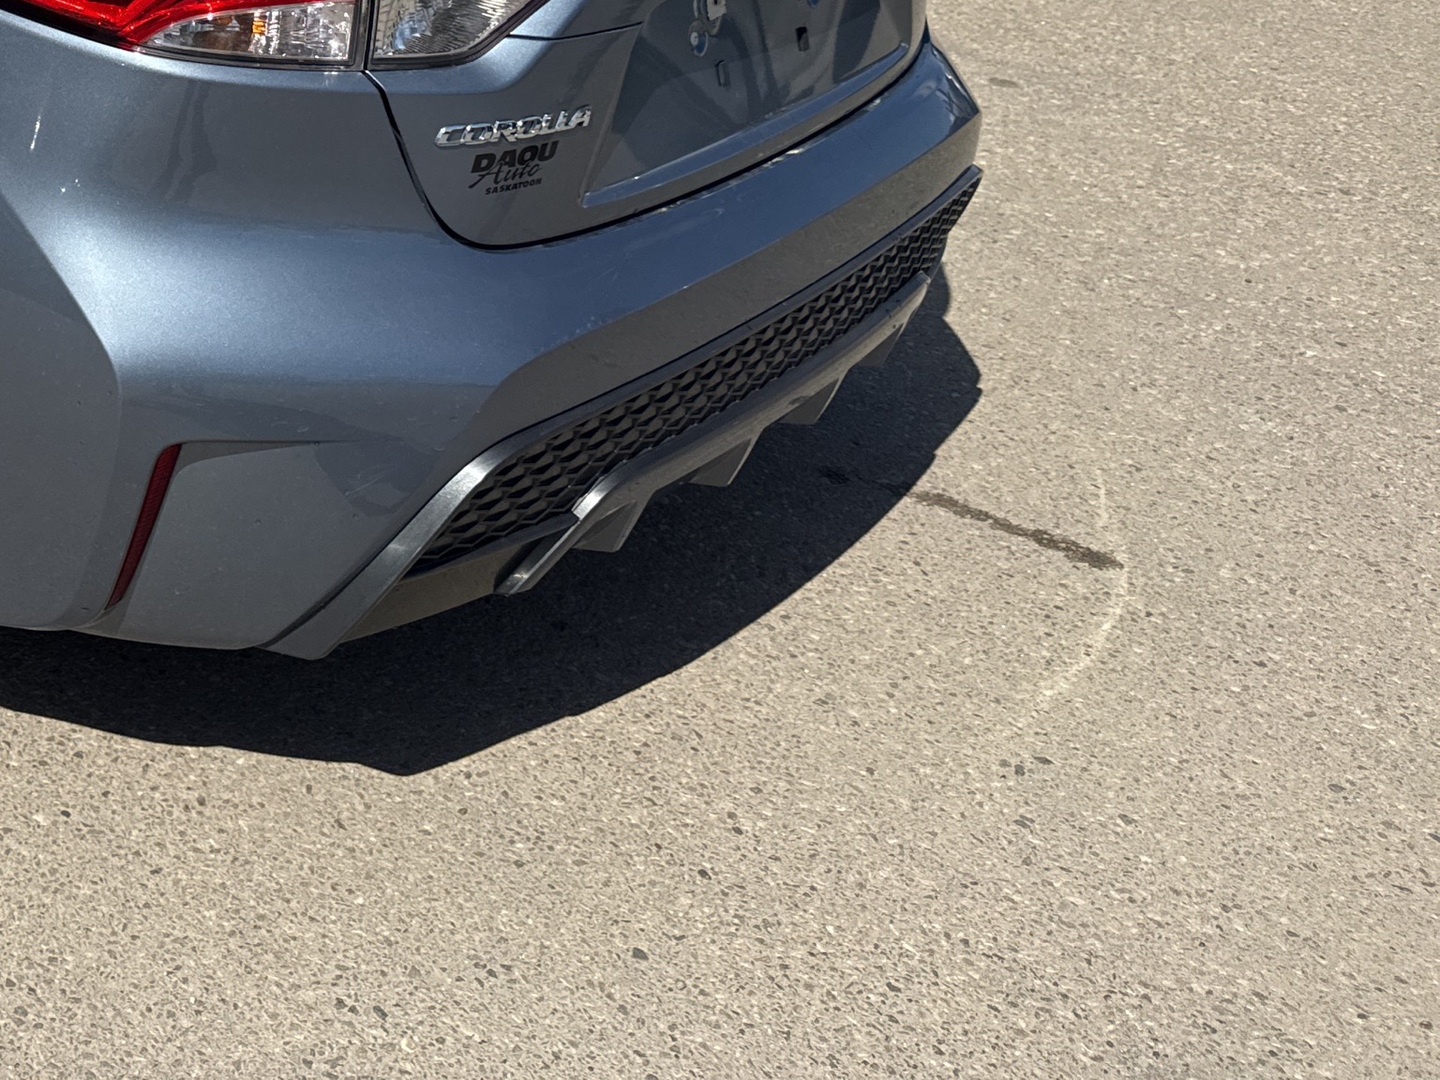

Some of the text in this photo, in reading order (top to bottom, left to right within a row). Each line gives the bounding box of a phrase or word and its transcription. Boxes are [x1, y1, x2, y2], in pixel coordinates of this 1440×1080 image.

[434, 104, 592, 148] COROLLA
[471, 140, 559, 173] DAOU
[468, 161, 541, 189] Auto
[485, 177, 542, 195] SASKATOON
